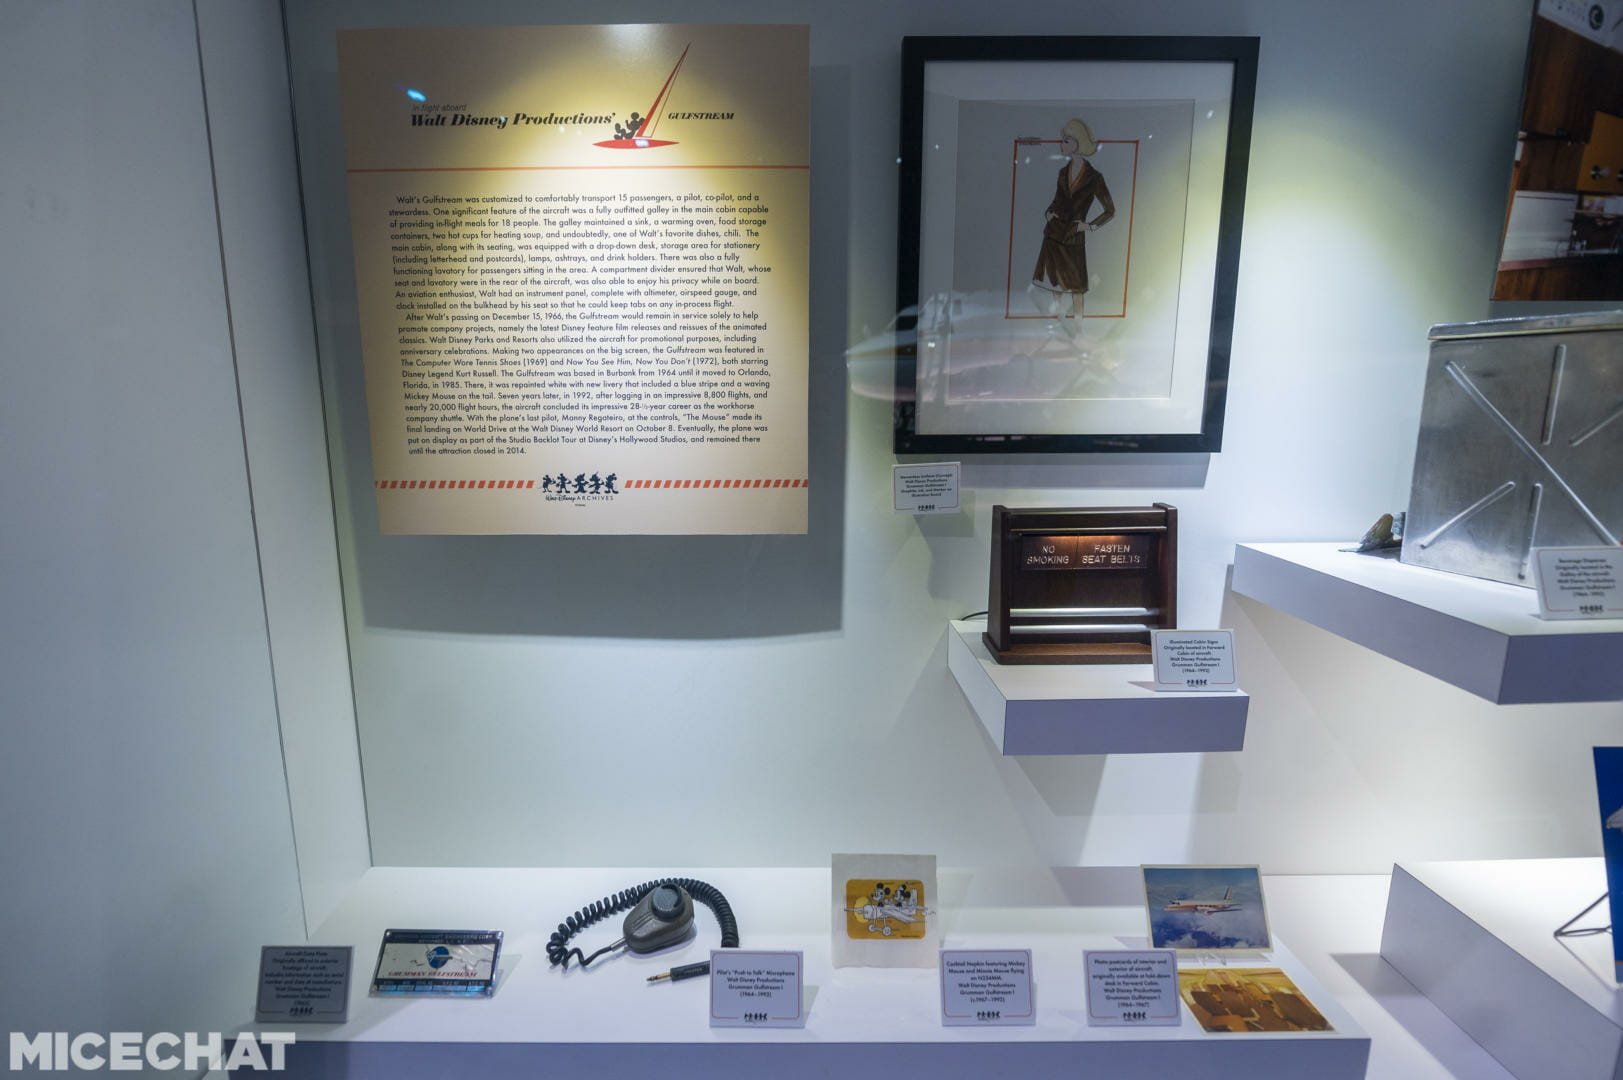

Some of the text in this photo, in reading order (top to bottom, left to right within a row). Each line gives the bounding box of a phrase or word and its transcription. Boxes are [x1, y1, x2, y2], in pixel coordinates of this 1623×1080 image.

[411, 114, 448, 126] Walt
[452, 114, 508, 129] Disney
[668, 112, 735, 120] GULFSTREAM
[433, 207, 449, 215] One
[451, 207, 488, 217] significant
[491, 206, 516, 215] feature
[519, 206, 527, 214] of
[529, 206, 540, 214] the
[543, 206, 569, 214] aircraft
[596, 205, 611, 216] fully
[614, 205, 644, 214] outfitted
[647, 205, 669, 216] galley
[672, 205, 678, 213] in
[681, 205, 692, 213] the
[695, 205, 713, 214] main
[716, 205, 736, 214] cabin
[738, 205, 768, 216] capable
[392, 244, 409, 252] main
[436, 243, 457, 253] along
[459, 243, 474, 251] with
[534, 242, 569, 252] equipped
[571, 242, 587, 250] with
[661, 241, 688, 251] storage
[711, 241, 721, 249] for
[724, 241, 760, 251] stationery
[405, 313, 424, 321] After
[452, 312, 478, 323] passing
[492, 312, 529, 320] December
[566, 312, 577, 320] the
[579, 312, 619, 320] Gulfstream
[621, 312, 643, 320] would
[646, 311, 671, 320] remain
[673, 311, 679, 320] in
[682, 311, 707, 320] service
[710, 311, 731, 322] solely
[733, 311, 740, 320] to
[743, 311, 758, 322] help
[432, 380, 439, 389] in
[489, 380, 493, 388] it
[512, 380, 545, 390] repainted
[548, 380, 567, 388] white
[569, 380, 584, 388] with
[603, 380, 623, 390] livery
[625, 380, 639, 388] that
[641, 379, 671, 388] included
[681, 379, 696, 388] blue
[699, 379, 718, 390] stripe
[721, 379, 734, 388] and
[744, 379, 770, 390] waving
[407, 424, 422, 433] final
[424, 424, 450, 435] landing
[464, 424, 486, 433] World
[488, 424, 507, 433] Drive
[509, 424, 516, 433] at
[518, 424, 529, 433] the
[531, 424, 548, 432] Walt
[550, 424, 574, 435] Disney
[576, 424, 598, 432] World
[601, 424, 622, 432] Resort
[636, 424, 665, 432] October
[718, 423, 729, 432] the
[732, 423, 752, 434] plane
[1042, 545, 1056, 554] NO
[1094, 544, 1130, 553] FASTEN
[1026, 556, 1069, 564] SMOKING
[1082, 554, 1140, 564] SEAT BELTS
